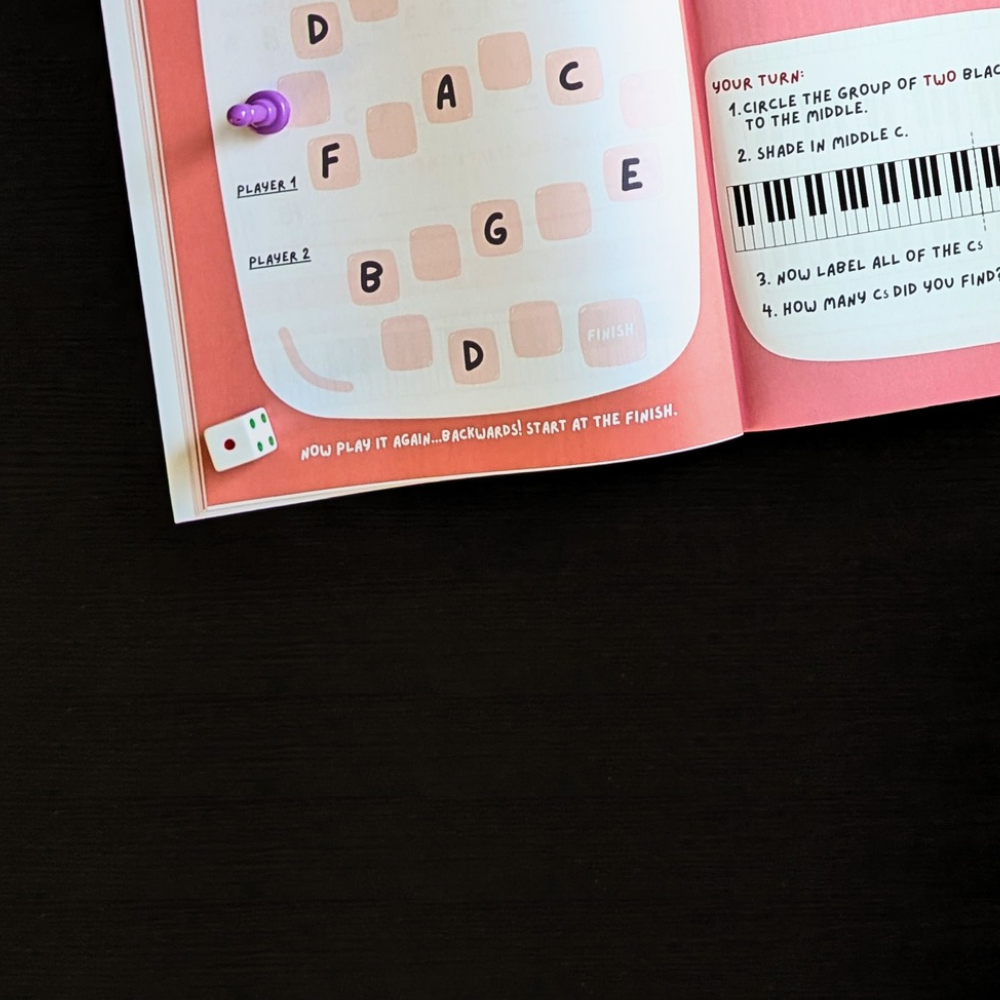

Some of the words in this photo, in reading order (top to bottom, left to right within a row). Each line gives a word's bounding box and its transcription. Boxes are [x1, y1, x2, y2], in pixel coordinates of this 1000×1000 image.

[308, 14, 328, 44] D
[559, 61, 583, 90] C
[712, 78, 752, 94] YOUR
[758, 70, 804, 86] TURN:
[437, 74, 456, 110] A
[744, 95, 796, 114] CIRCLE
[803, 89, 831, 104] THE
[838, 81, 891, 100] GROUP
[898, 77, 916, 90] OF
[923, 70, 956, 86] TWO
[745, 117, 764, 130] TO
[771, 111, 800, 126] THE
[807, 102, 867, 123] MIDDLE.
[322, 143, 340, 178] F
[738, 149, 751, 163] 2.
[758, 141, 804, 160] SHADE
[811, 139, 825, 152] IN
[833, 128, 888, 150] MIDDLE
[895, 126, 908, 137] C.
[237, 180, 286, 196] PLAYER
[290, 176, 296, 188] 1
[622, 158, 643, 191] E
[484, 212, 507, 245] G
[249, 251, 297, 268] PLAYER
[303, 248, 310, 259] 2
[757, 272, 770, 286] 3.
[777, 269, 810, 285] NOW
[817, 260, 865, 277] LABEL
[873, 254, 900, 269] ALL
[906, 249, 925, 262] OF
[932, 242, 961, 258] THE
[361, 261, 383, 293] B
[763, 304, 777, 318] 4.
[784, 301, 816, 316] HOW
[824, 291, 866, 310] MANY
[893, 283, 917, 297] DID
[923, 278, 954, 293] YOU
[588, 322, 634, 341] FINISH
[463, 340, 483, 371] D
[301, 445, 331, 460] NOW
[337, 438, 370, 455] PLAY
[376, 437, 387, 449] IT
[527, 420, 566, 434] START
[573, 417, 588, 431] AT
[593, 413, 620, 427] THE
[626, 403, 677, 424] FINISH.
